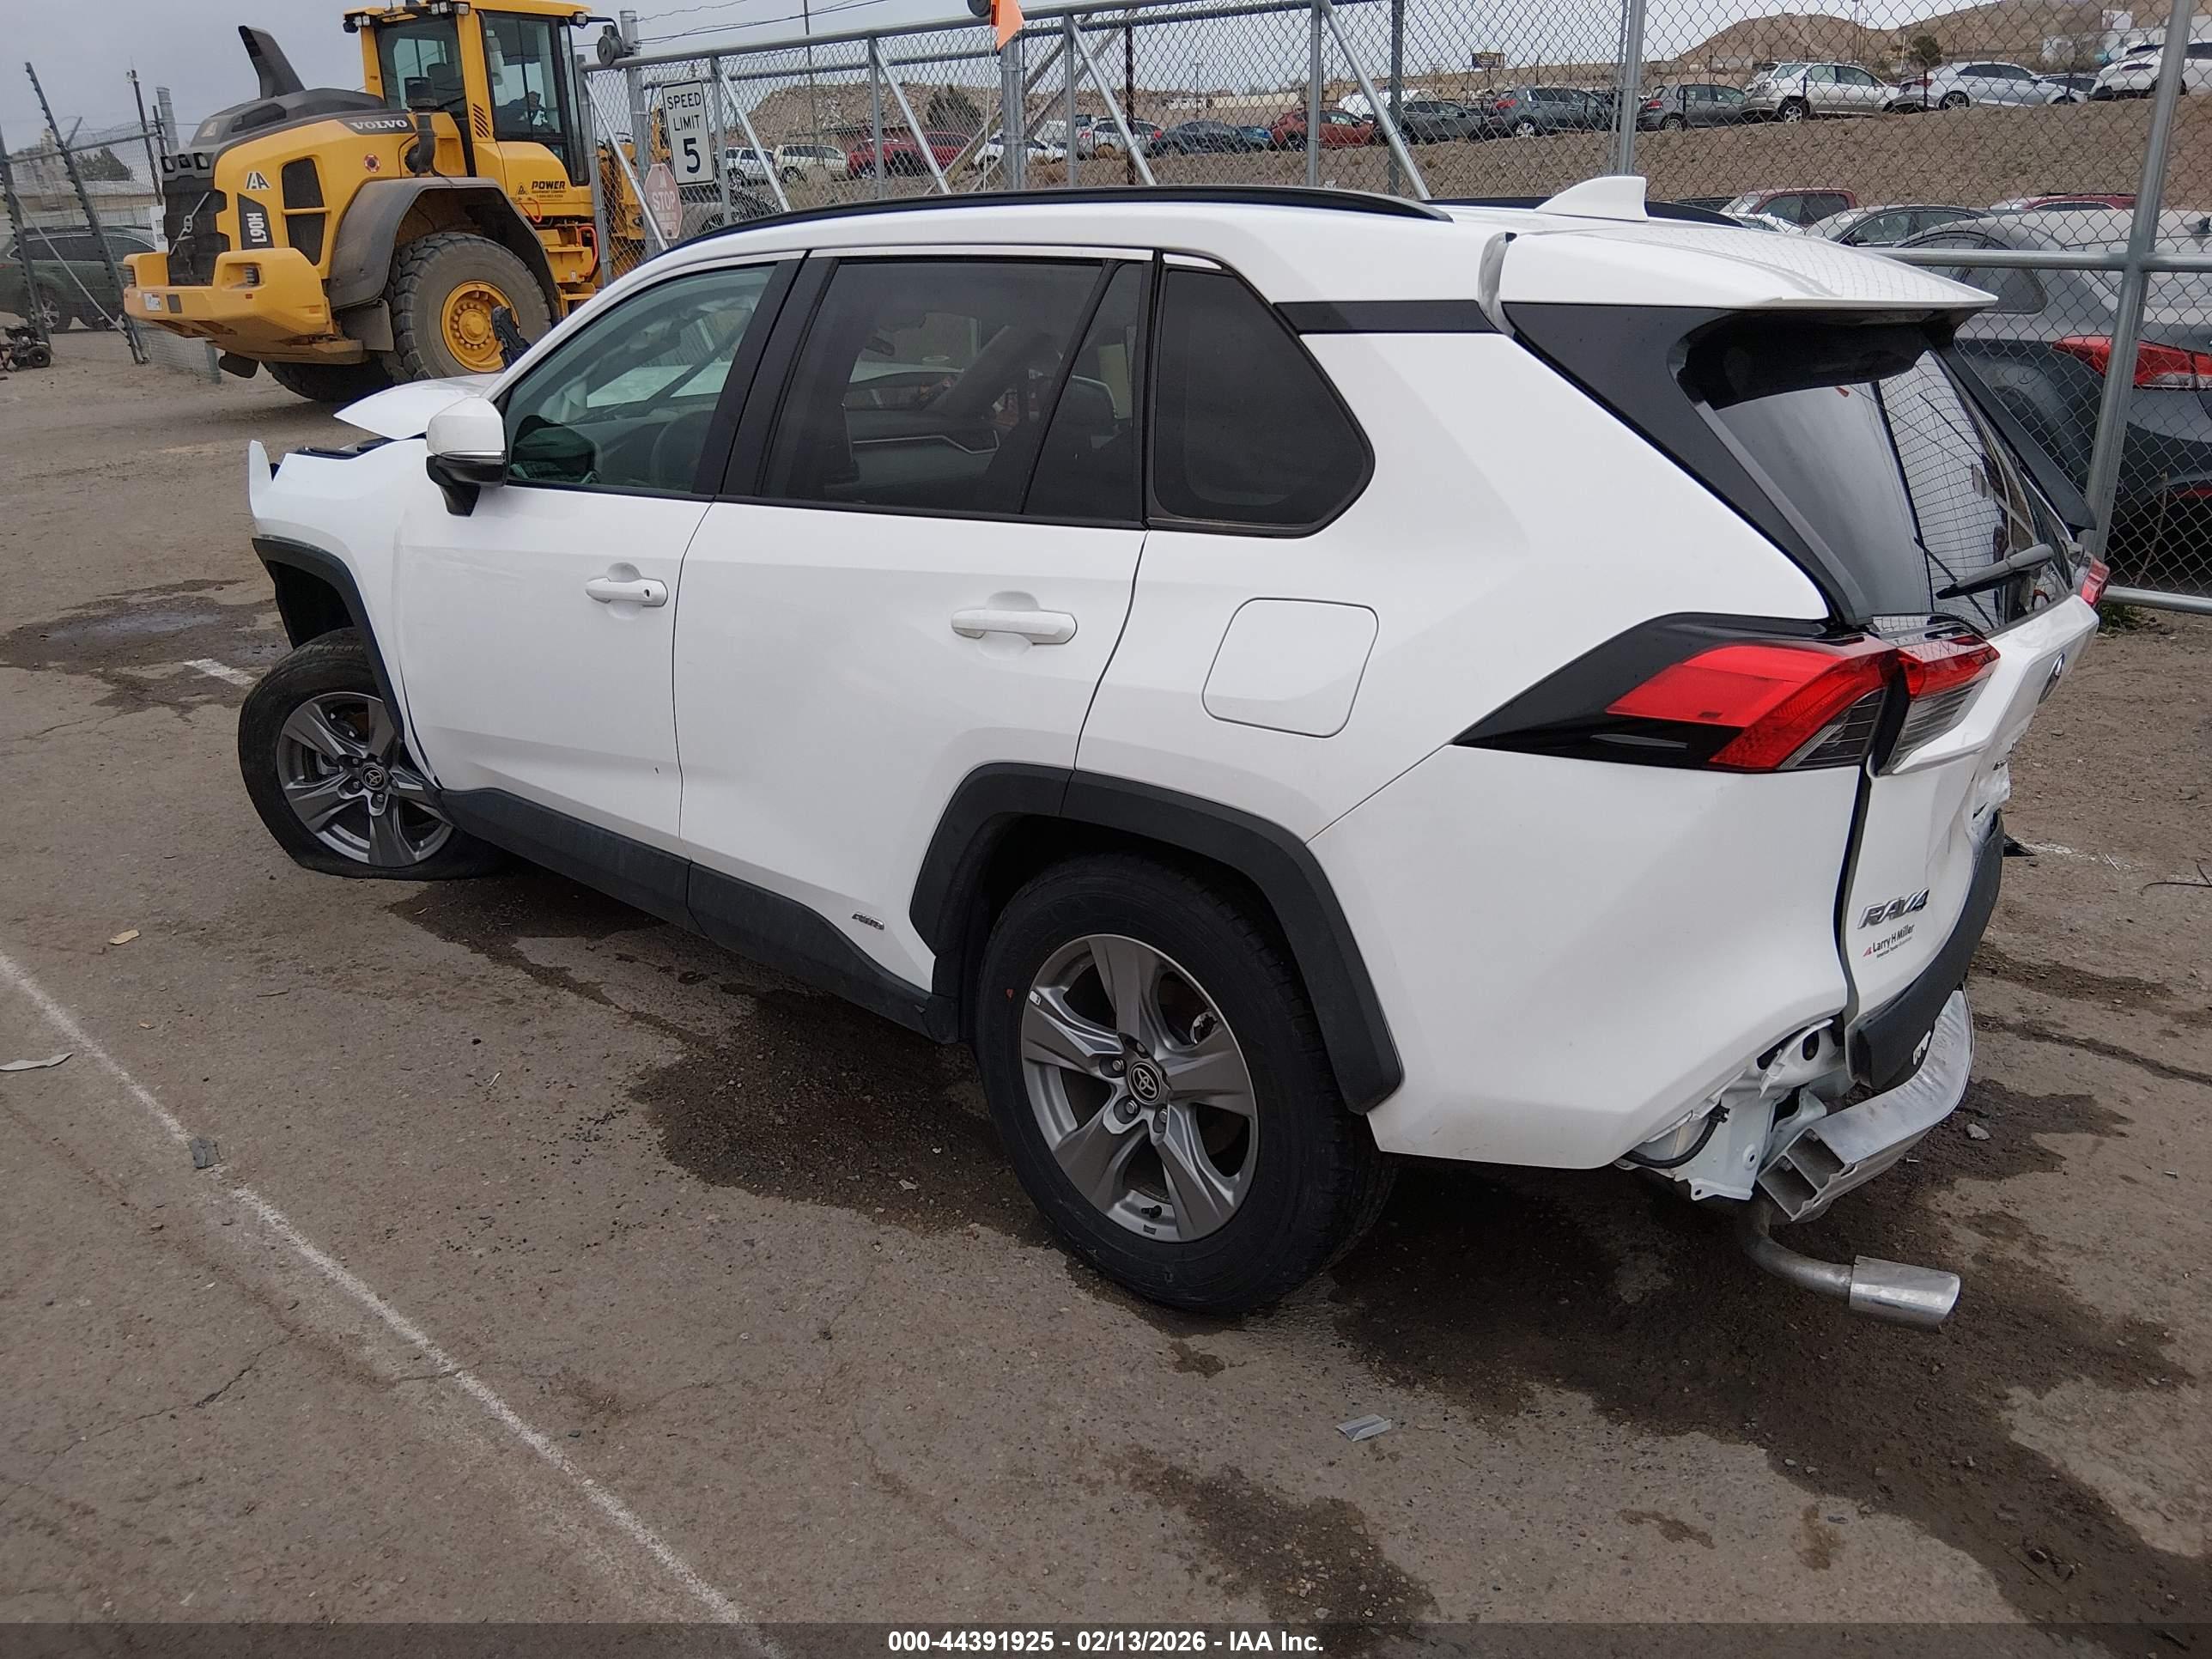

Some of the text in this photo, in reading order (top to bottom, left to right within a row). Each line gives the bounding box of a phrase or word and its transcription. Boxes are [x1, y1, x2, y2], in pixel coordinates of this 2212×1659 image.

[667, 92, 701, 110] SPEED
[349, 119, 408, 130] VOLVO
[673, 114, 700, 131] LIMIT
[683, 137, 701, 173] 5
[532, 180, 566, 190] POWER
[652, 191, 676, 211] STOP
[246, 212, 268, 243] L90H
[1856, 887, 1929, 929] RAV4
[1872, 937, 1891, 952] Larry
[1896, 924, 1915, 941] Miller
